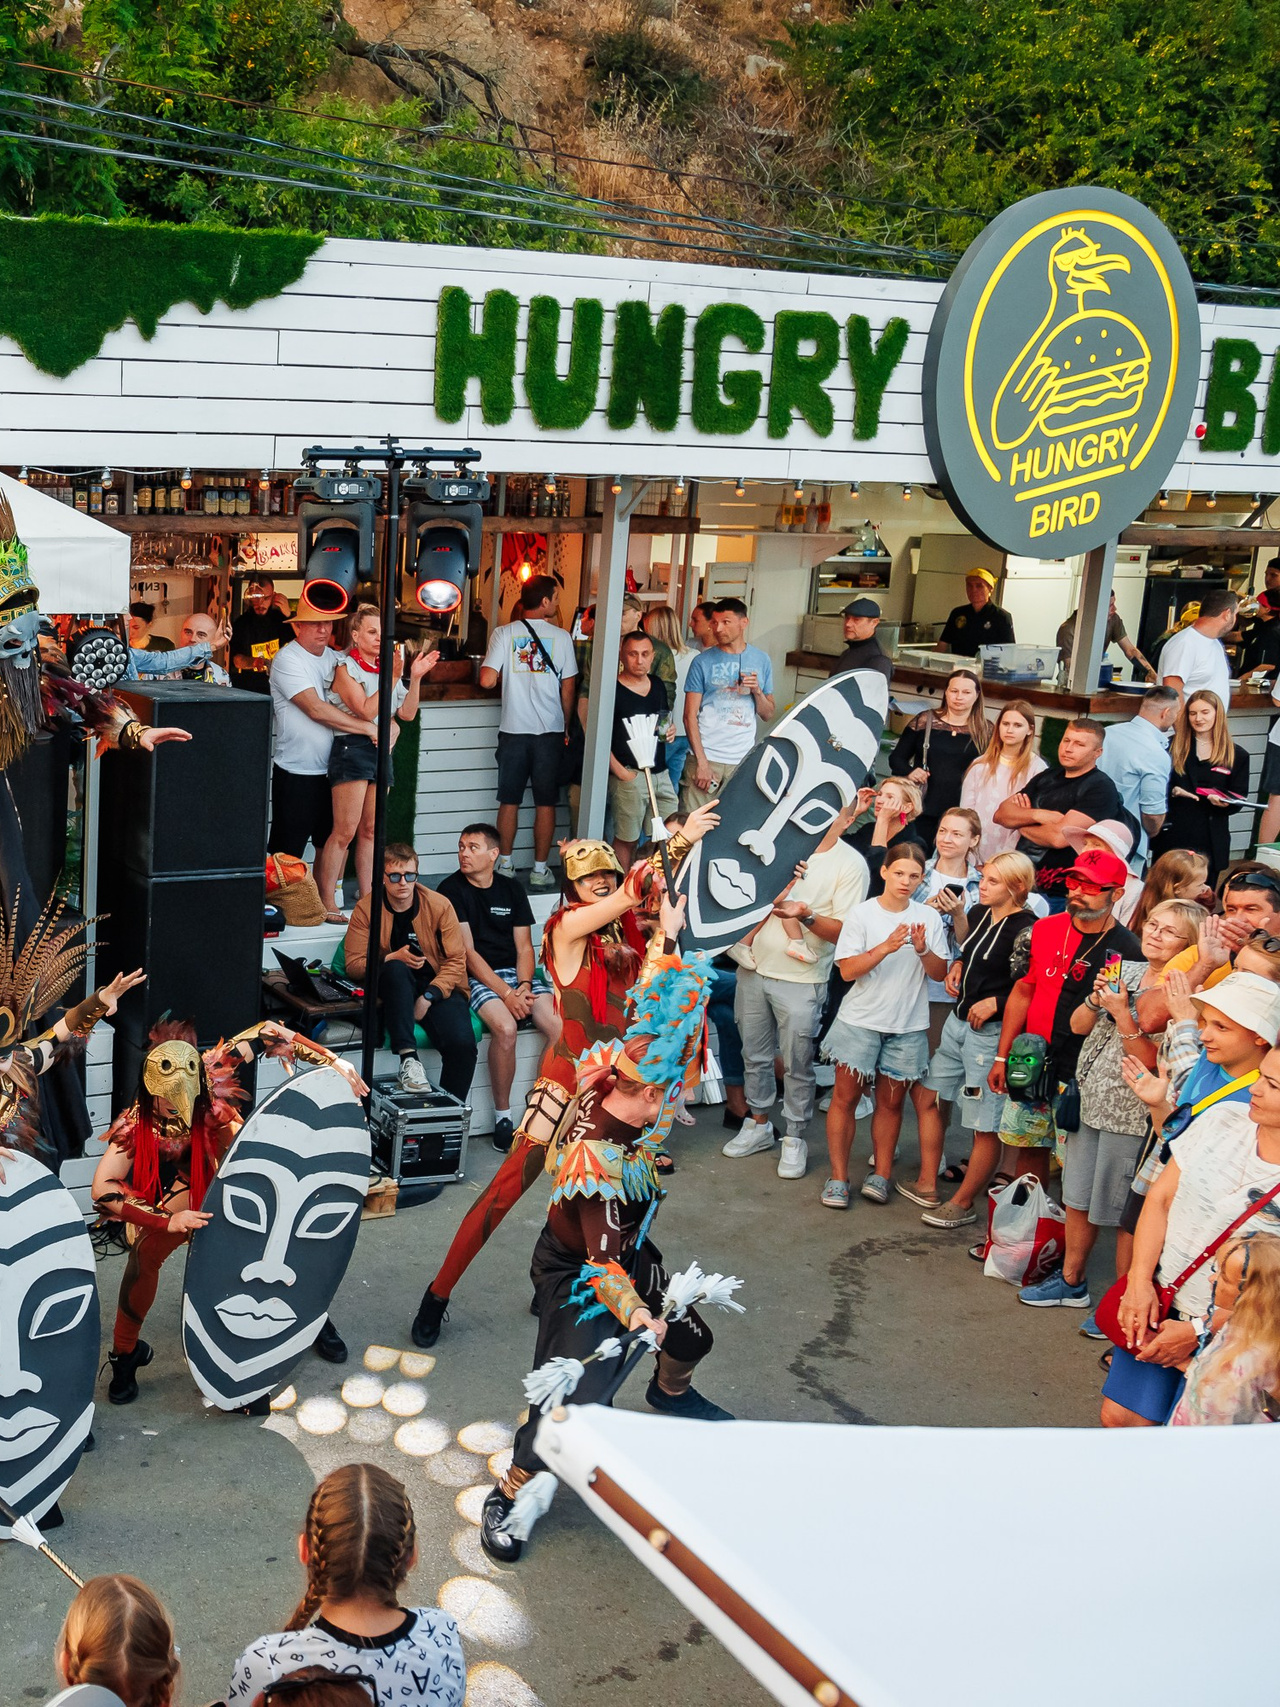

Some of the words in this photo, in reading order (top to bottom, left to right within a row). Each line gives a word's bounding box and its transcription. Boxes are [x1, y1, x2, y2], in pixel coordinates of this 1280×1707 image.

[434, 285, 908, 440] HUNGRY
[1010, 424, 1139, 487] HUNGRY
[1029, 490, 1101, 539] BIRD
